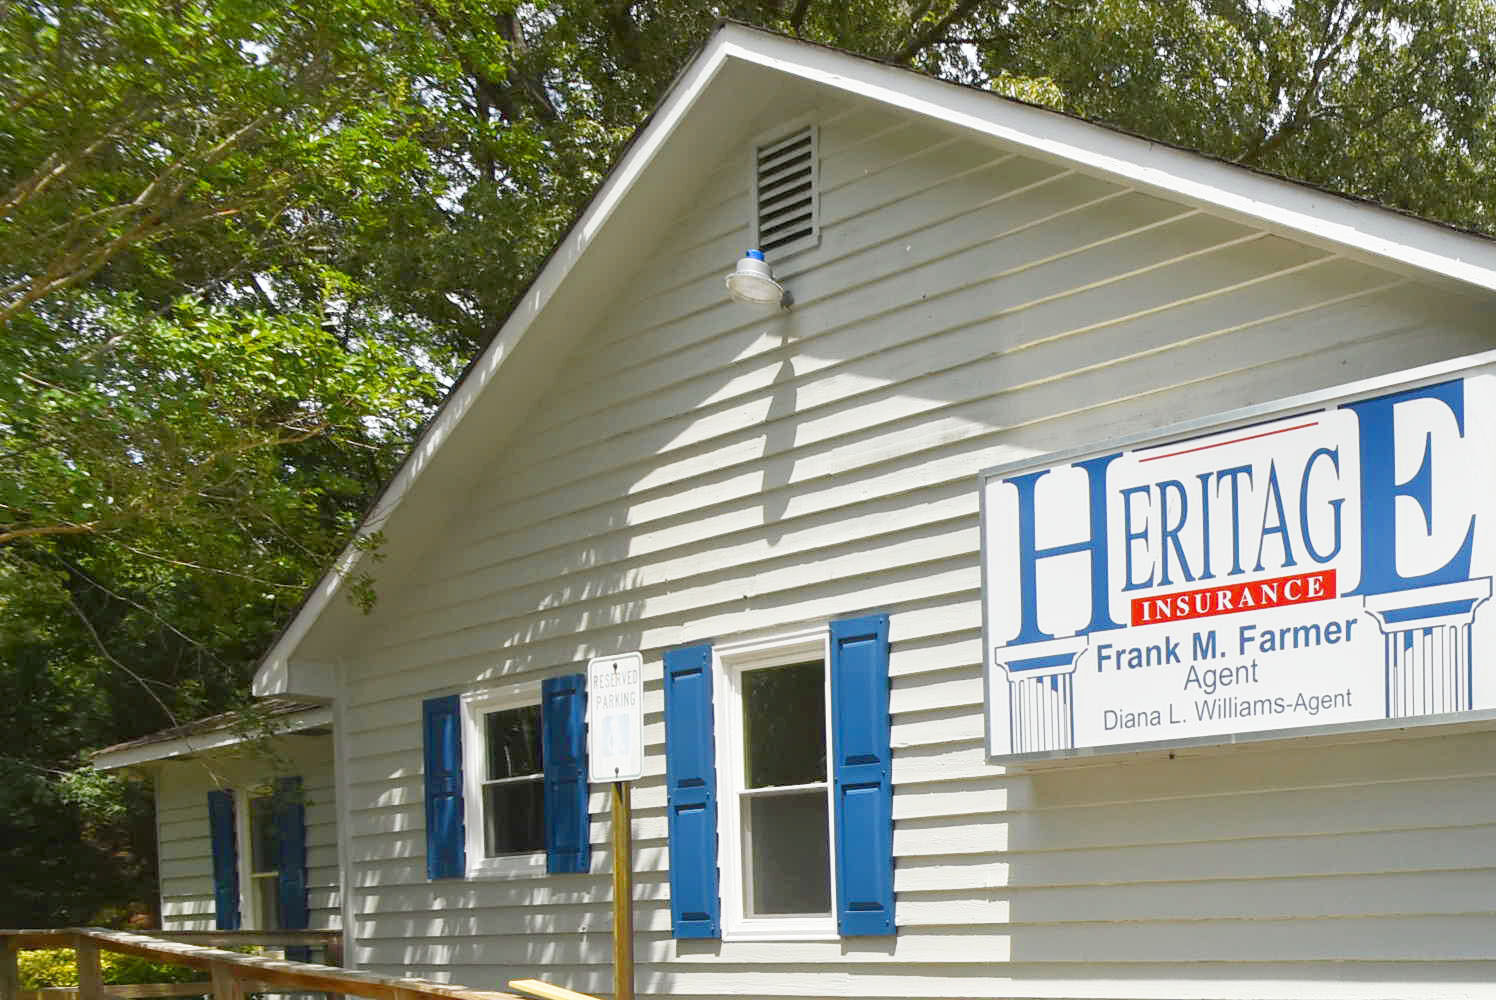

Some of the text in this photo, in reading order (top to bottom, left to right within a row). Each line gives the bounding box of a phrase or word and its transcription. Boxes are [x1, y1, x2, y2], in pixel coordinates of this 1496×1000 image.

[1002, 378, 1477, 648] HERITAGE
[1140, 575, 1325, 622] INSURANCE
[1096, 618, 1358, 673] Frank M. Farmer
[593, 670, 637, 689] RESERVED
[1183, 657, 1259, 695] Agent
[596, 693, 636, 711] PARKING
[1103, 688, 1353, 731] Diana L. Williams-Agent
